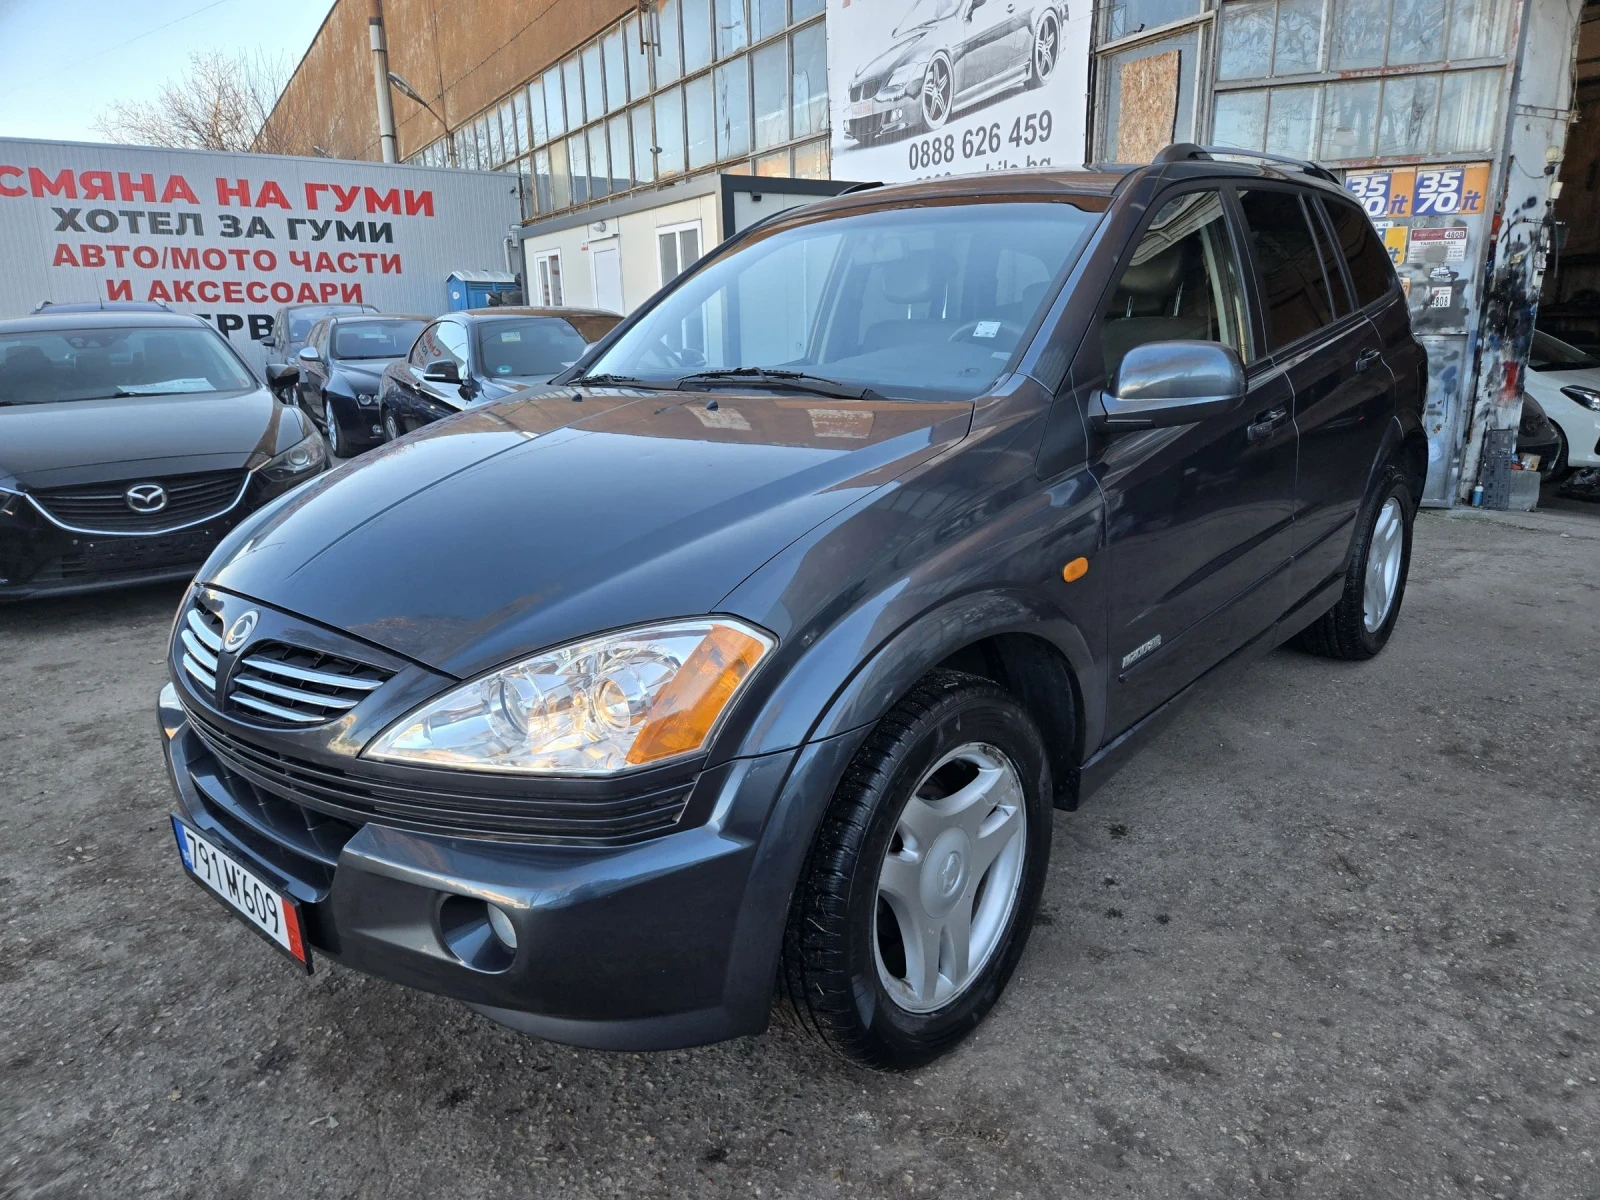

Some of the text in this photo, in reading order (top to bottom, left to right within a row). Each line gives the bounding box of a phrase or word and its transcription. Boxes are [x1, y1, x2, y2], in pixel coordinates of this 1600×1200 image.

[909, 134, 954, 170] 0888
[962, 123, 1001, 159] 626
[1008, 109, 1053, 148] 459
[0, 165, 435, 217] СМЯНА НА ГУМИ
[1351, 176, 1388, 197] 35
[1418, 172, 1461, 193] 35
[51, 207, 393, 243] ХОТЕЛ ЗА ГУМИ
[1446, 231, 1464, 239] 4808
[52, 243, 402, 274] АВТО/МОТО ЧАСТИ
[106, 279, 362, 304] И АКСЕСОАРИ
